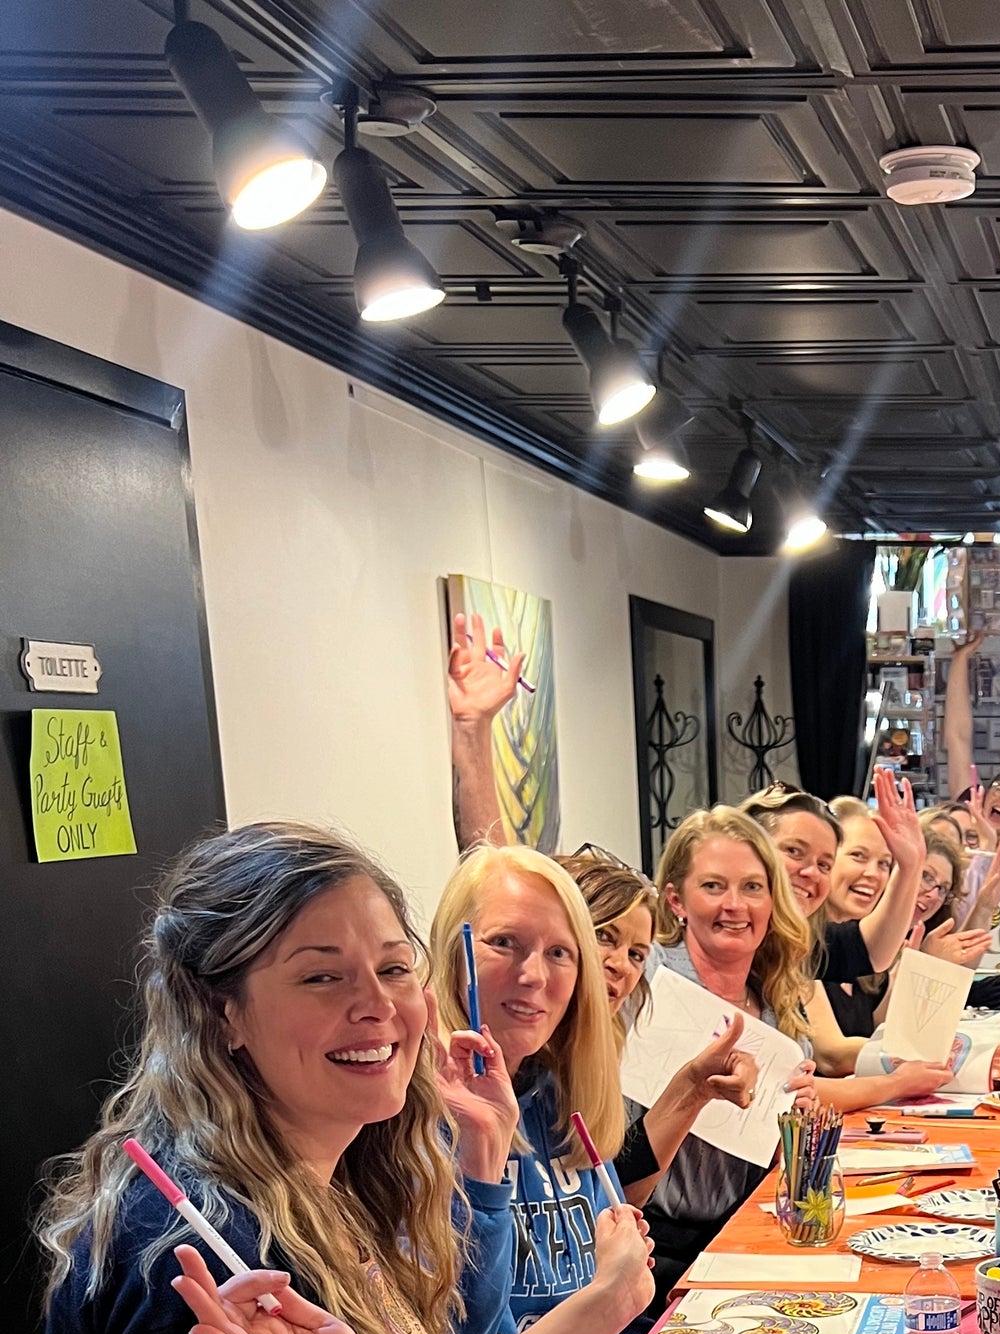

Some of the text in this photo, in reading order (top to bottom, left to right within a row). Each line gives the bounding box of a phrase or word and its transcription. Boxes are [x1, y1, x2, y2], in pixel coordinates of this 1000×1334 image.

[37, 656, 89, 678] TOILETTE
[43, 716, 96, 769] Staff
[34, 772, 78, 821] Party
[57, 822, 98, 854] ONLY
